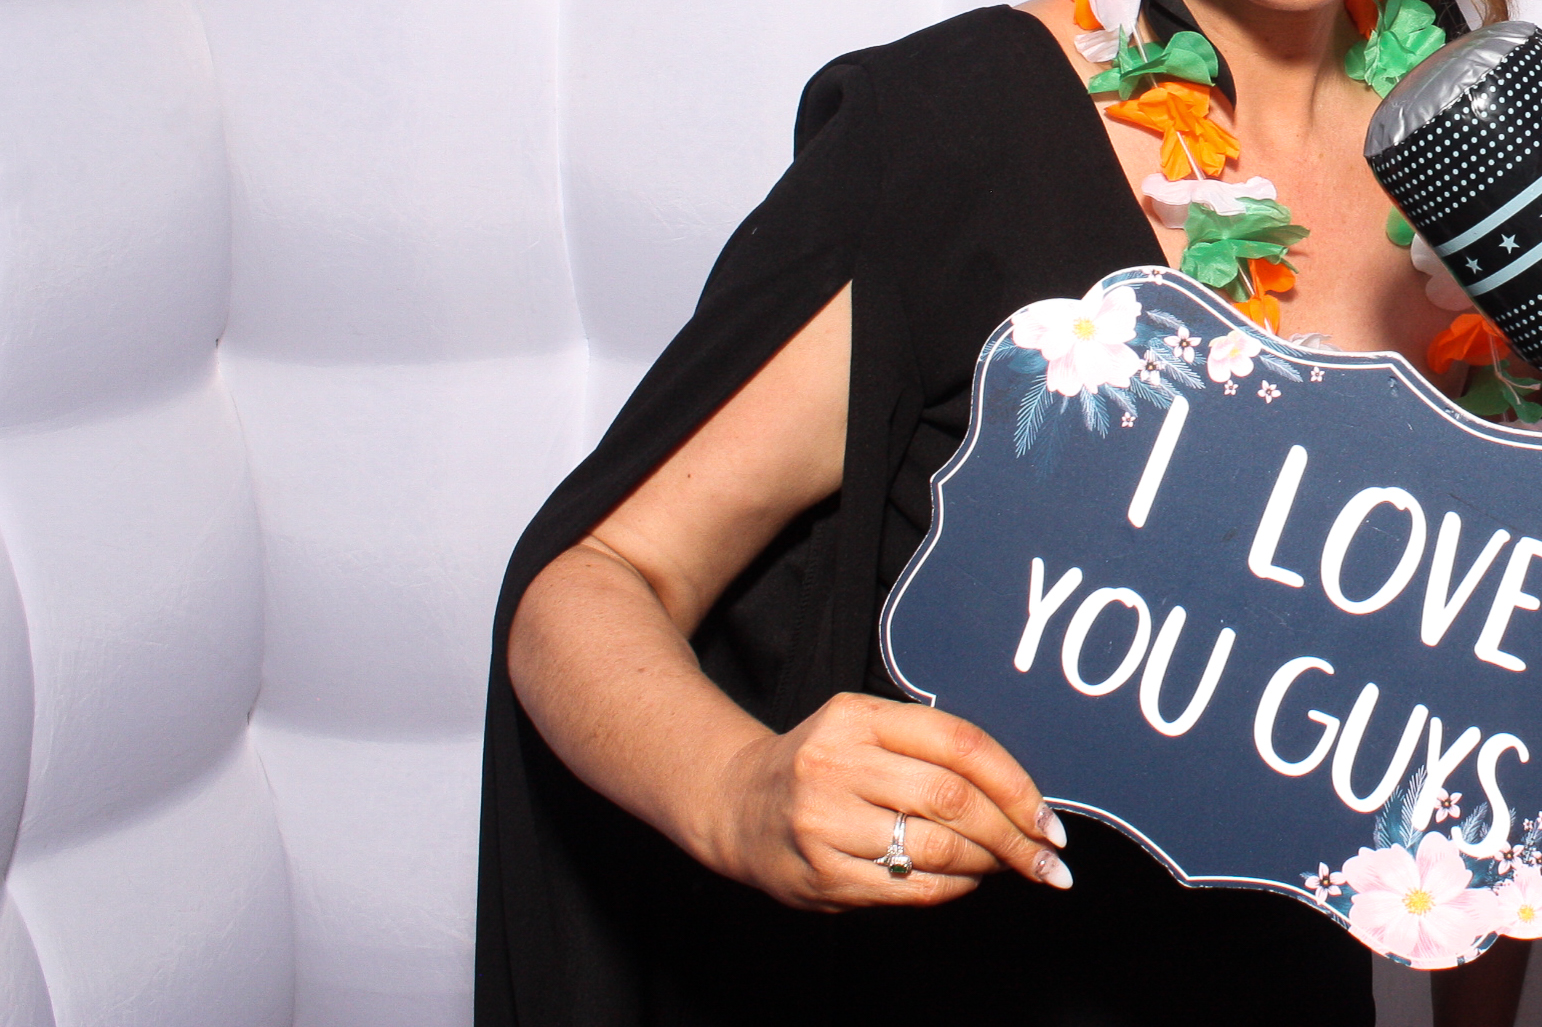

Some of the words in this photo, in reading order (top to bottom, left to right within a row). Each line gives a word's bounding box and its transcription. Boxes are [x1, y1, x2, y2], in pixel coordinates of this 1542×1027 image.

[1126, 394, 1190, 528] I
[1013, 556, 1236, 737] YOU
[1253, 656, 1531, 859] GUYS
